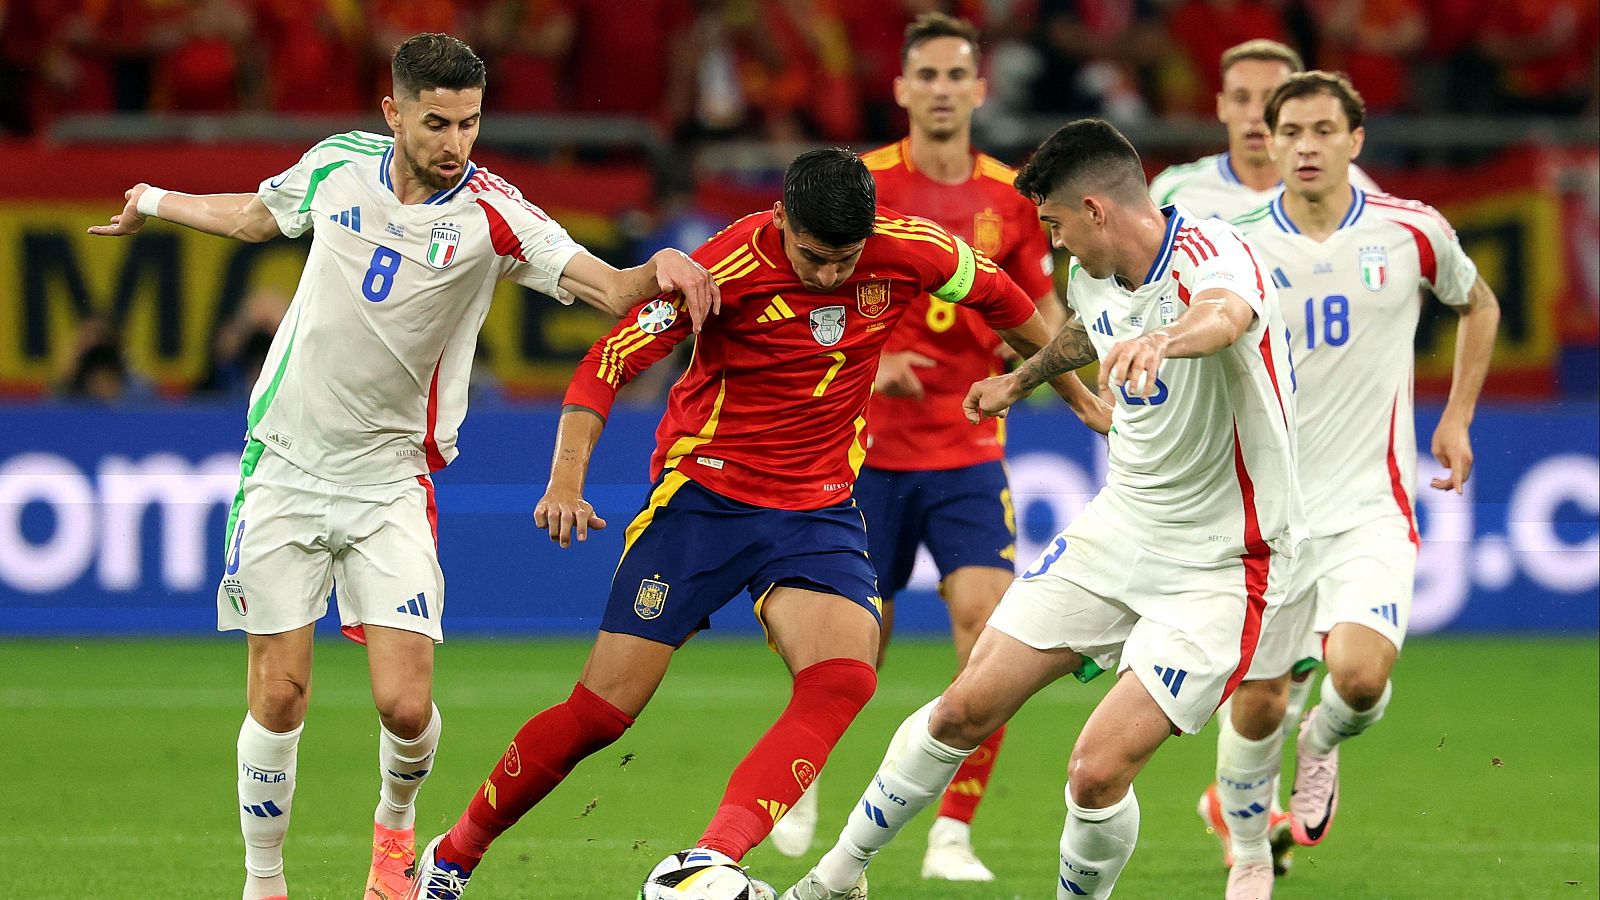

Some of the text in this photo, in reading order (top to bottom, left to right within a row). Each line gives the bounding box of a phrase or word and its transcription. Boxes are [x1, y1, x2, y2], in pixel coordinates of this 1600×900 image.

[433, 231, 458, 242] ITALIA
[361, 245, 402, 303] 8
[1305, 295, 1349, 349] 18
[812, 351, 847, 396] 7
[242, 763, 286, 784] ITALIA
